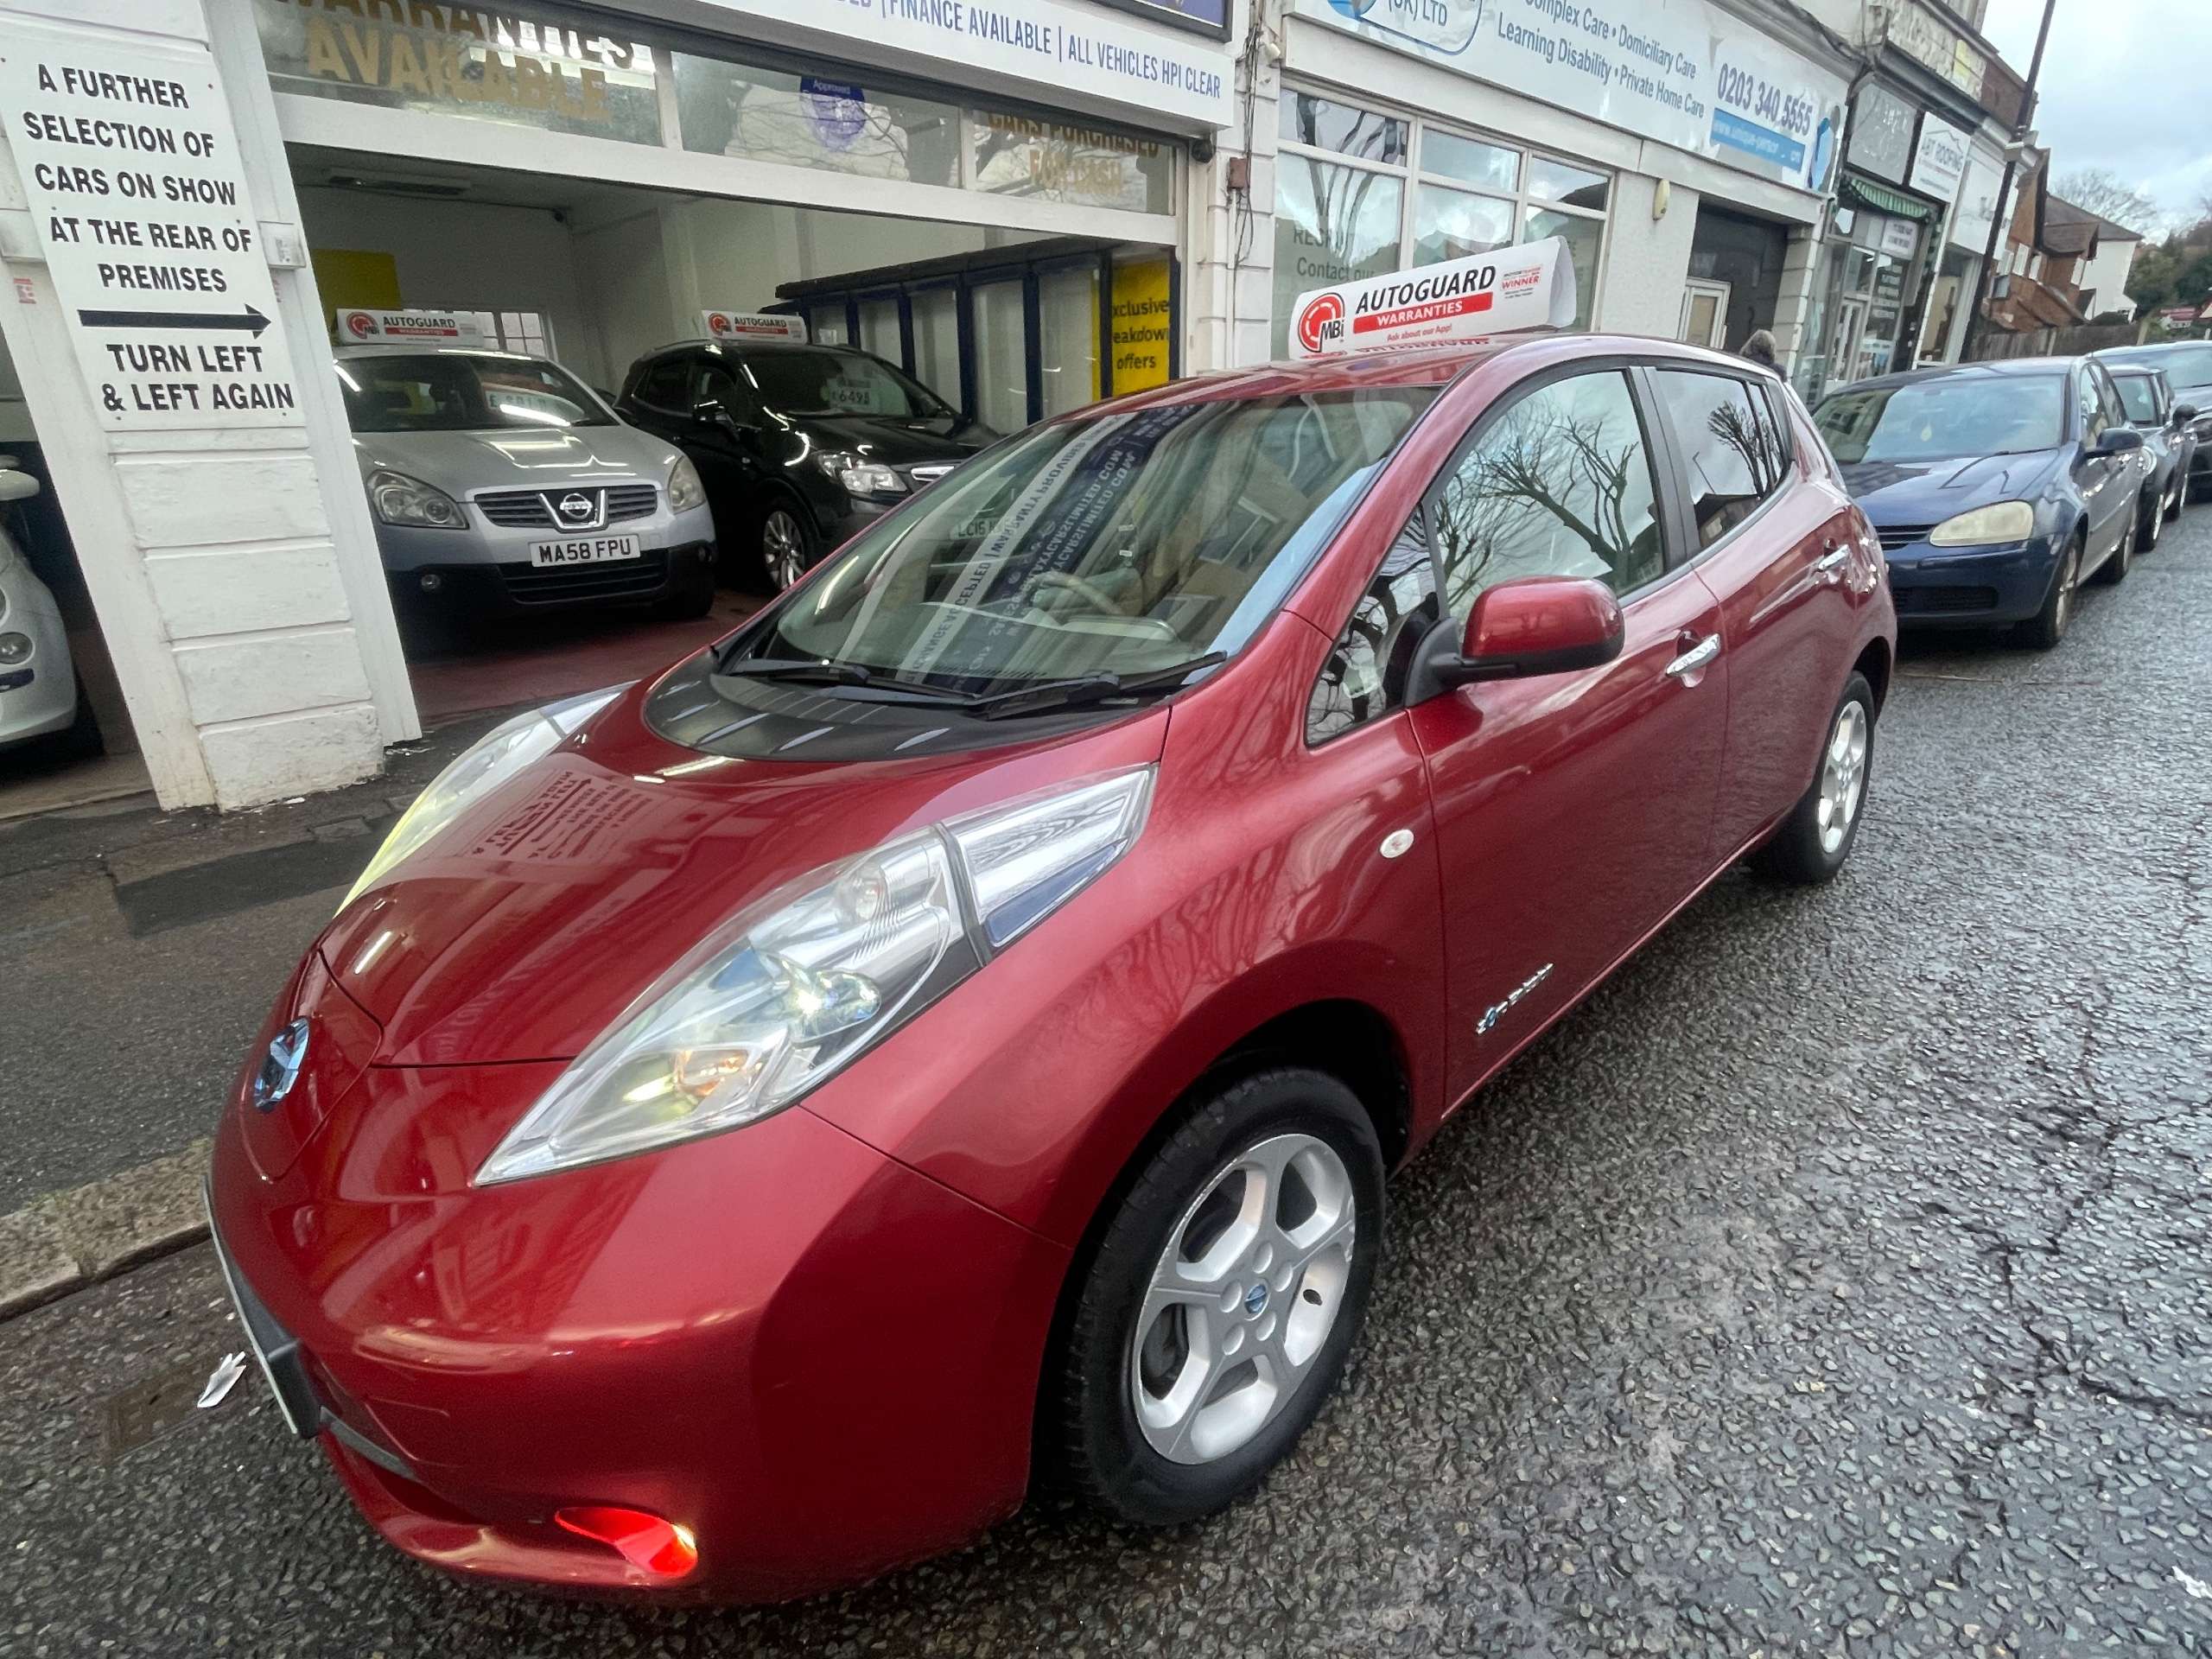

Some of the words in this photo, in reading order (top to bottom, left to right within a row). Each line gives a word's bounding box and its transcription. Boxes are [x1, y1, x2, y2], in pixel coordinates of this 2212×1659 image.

[1422, 0, 1447, 27] LTD
[969, 7, 1052, 54] AVAILABLE
[1069, 35, 1093, 65] ALL
[1097, 41, 1158, 81] VEHICLES
[1161, 59, 1182, 88] HPI
[1185, 67, 1221, 99] CLEAR
[1525, 0, 1580, 28] omplex
[1583, 8, 1610, 40] Care
[1618, 24, 1675, 74] Domiciliary
[1675, 52, 1697, 79] Care
[1497, 11, 1555, 64] Learning
[1558, 38, 1612, 86] Disability
[1619, 64, 1655, 99] Private
[1655, 79, 1682, 108] Home
[1684, 92, 1705, 119] Care
[38, 63, 58, 92] A
[61, 67, 189, 109] FURTHER
[1718, 63, 1754, 111] 0203
[1755, 81, 1781, 123] 340
[1781, 94, 1813, 137] 5555
[22, 111, 177, 154] SELECTION
[182, 130, 214, 158] OF
[35, 163, 110, 195] CARS
[117, 171, 156, 200] ON
[163, 175, 236, 206] SHOW
[50, 216, 79, 243] AT
[87, 219, 143, 246] THE
[148, 223, 217, 251] REAR
[222, 228, 251, 252] OF
[98, 264, 227, 293] PREMISES
[1297, 257, 1350, 281] Contact
[1502, 276, 1539, 289] WINNER
[1356, 265, 1496, 315] AUTOGUARD
[1112, 297, 1169, 318] xclusive
[1377, 301, 1463, 327] WARRANTIES
[383, 316, 455, 328] AUTOGUARD
[734, 318, 787, 327] AUTOGUARD
[1321, 319, 1344, 340] MBi
[1387, 333, 1399, 343] Ask
[1399, 330, 1421, 340] about
[106, 344, 193, 372] TURN
[199, 345, 263, 372] LEFT
[1116, 353, 1155, 371] offers
[101, 383, 127, 411] &
[130, 384, 200, 411] LEFT
[213, 383, 295, 410] AGAIN
[539, 543, 591, 563] MA58
[596, 538, 631, 558] FPU
